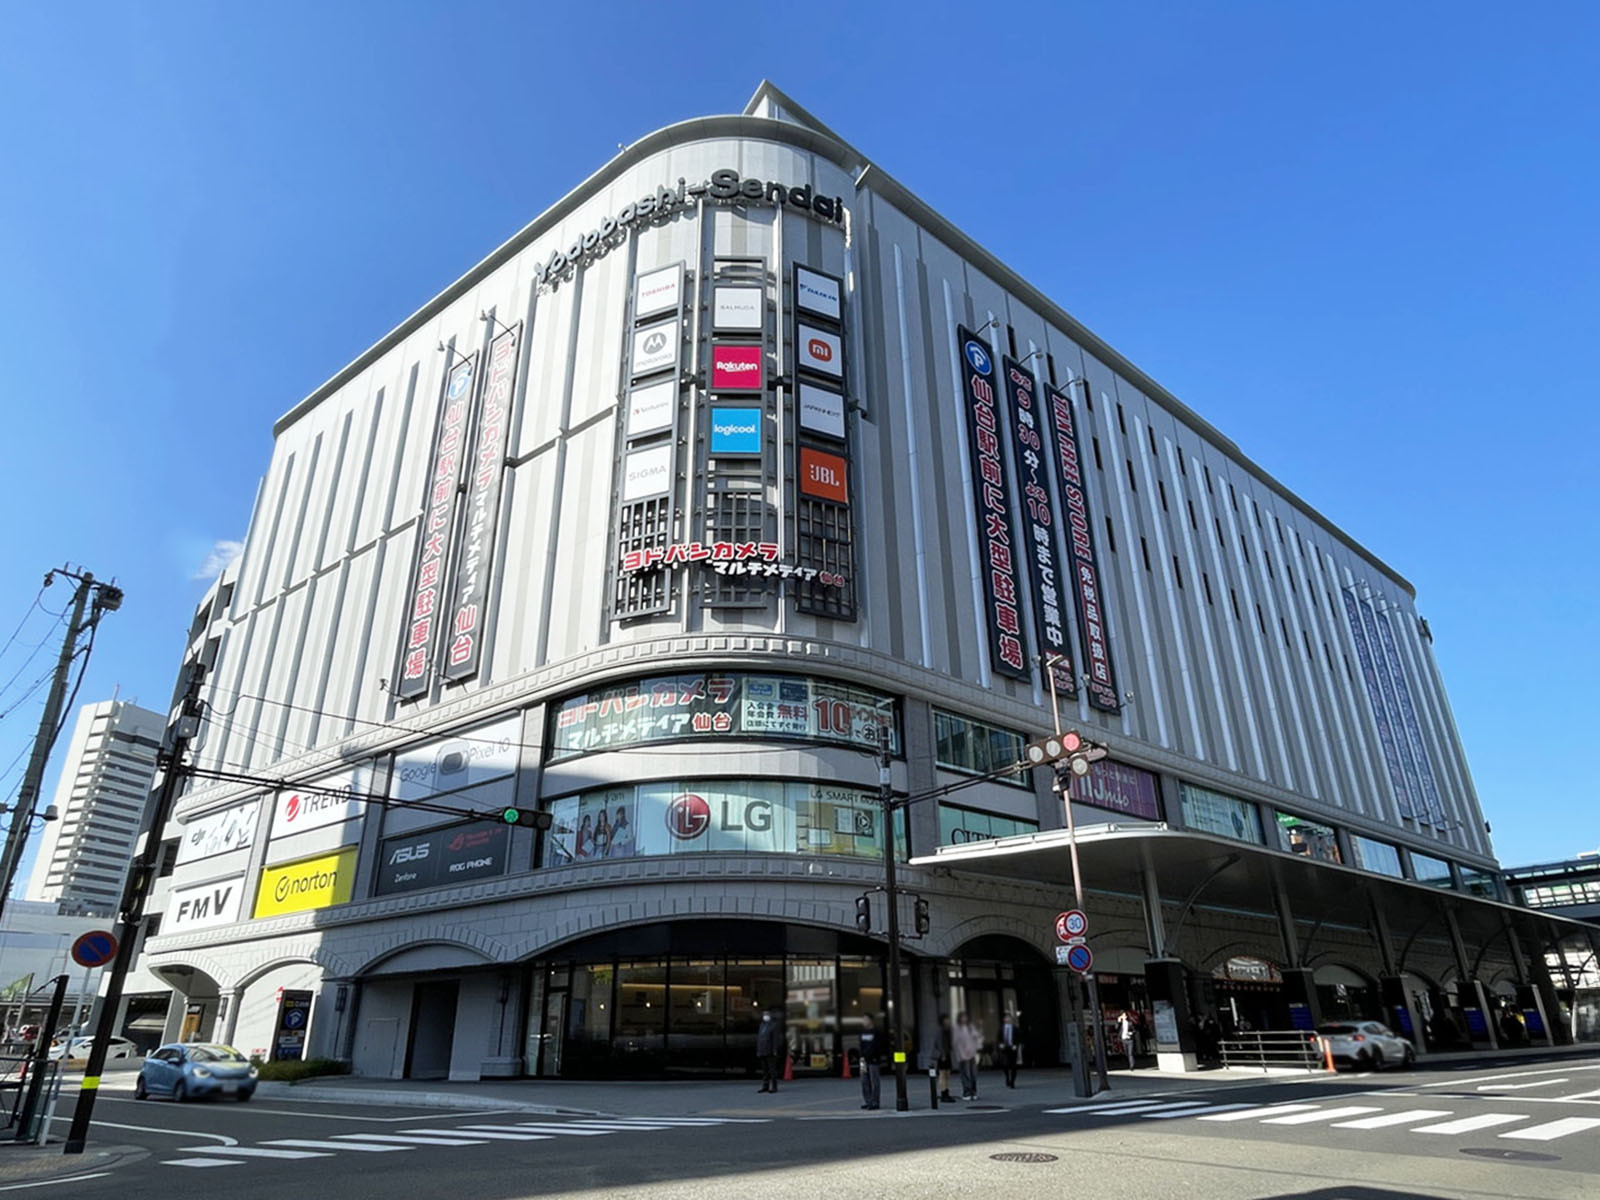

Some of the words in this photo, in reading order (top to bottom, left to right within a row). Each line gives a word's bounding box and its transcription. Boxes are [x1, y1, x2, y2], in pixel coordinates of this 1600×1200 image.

[533, 168, 843, 284] Yodobashi-Sendai
[641, 283, 676, 298] TOSHIBA
[716, 361, 758, 373] Rakuten
[713, 423, 756, 436] logicool
[1052, 394, 1074, 437] TAX
[628, 465, 667, 481] SIGMA
[809, 464, 840, 486] JBL
[1058, 433, 1082, 488] FREE
[970, 373, 1024, 671] 仙台駅前に大型駐車場
[1065, 484, 1093, 562] STORE
[403, 400, 466, 680] 仙台駅前に大型駐車場
[623, 541, 780, 572] ヨドバシカメラ
[557, 677, 736, 730] ヨドバシカメラ
[777, 703, 809, 721] 無料
[497, 737, 511, 754] 10
[400, 761, 437, 783] Google
[302, 784, 353, 815] TREND
[720, 801, 772, 832] LG
[388, 842, 432, 866] ASUS
[288, 868, 338, 896] norton
[176, 886, 233, 923] FMV
[1068, 917, 1082, 930] 30
